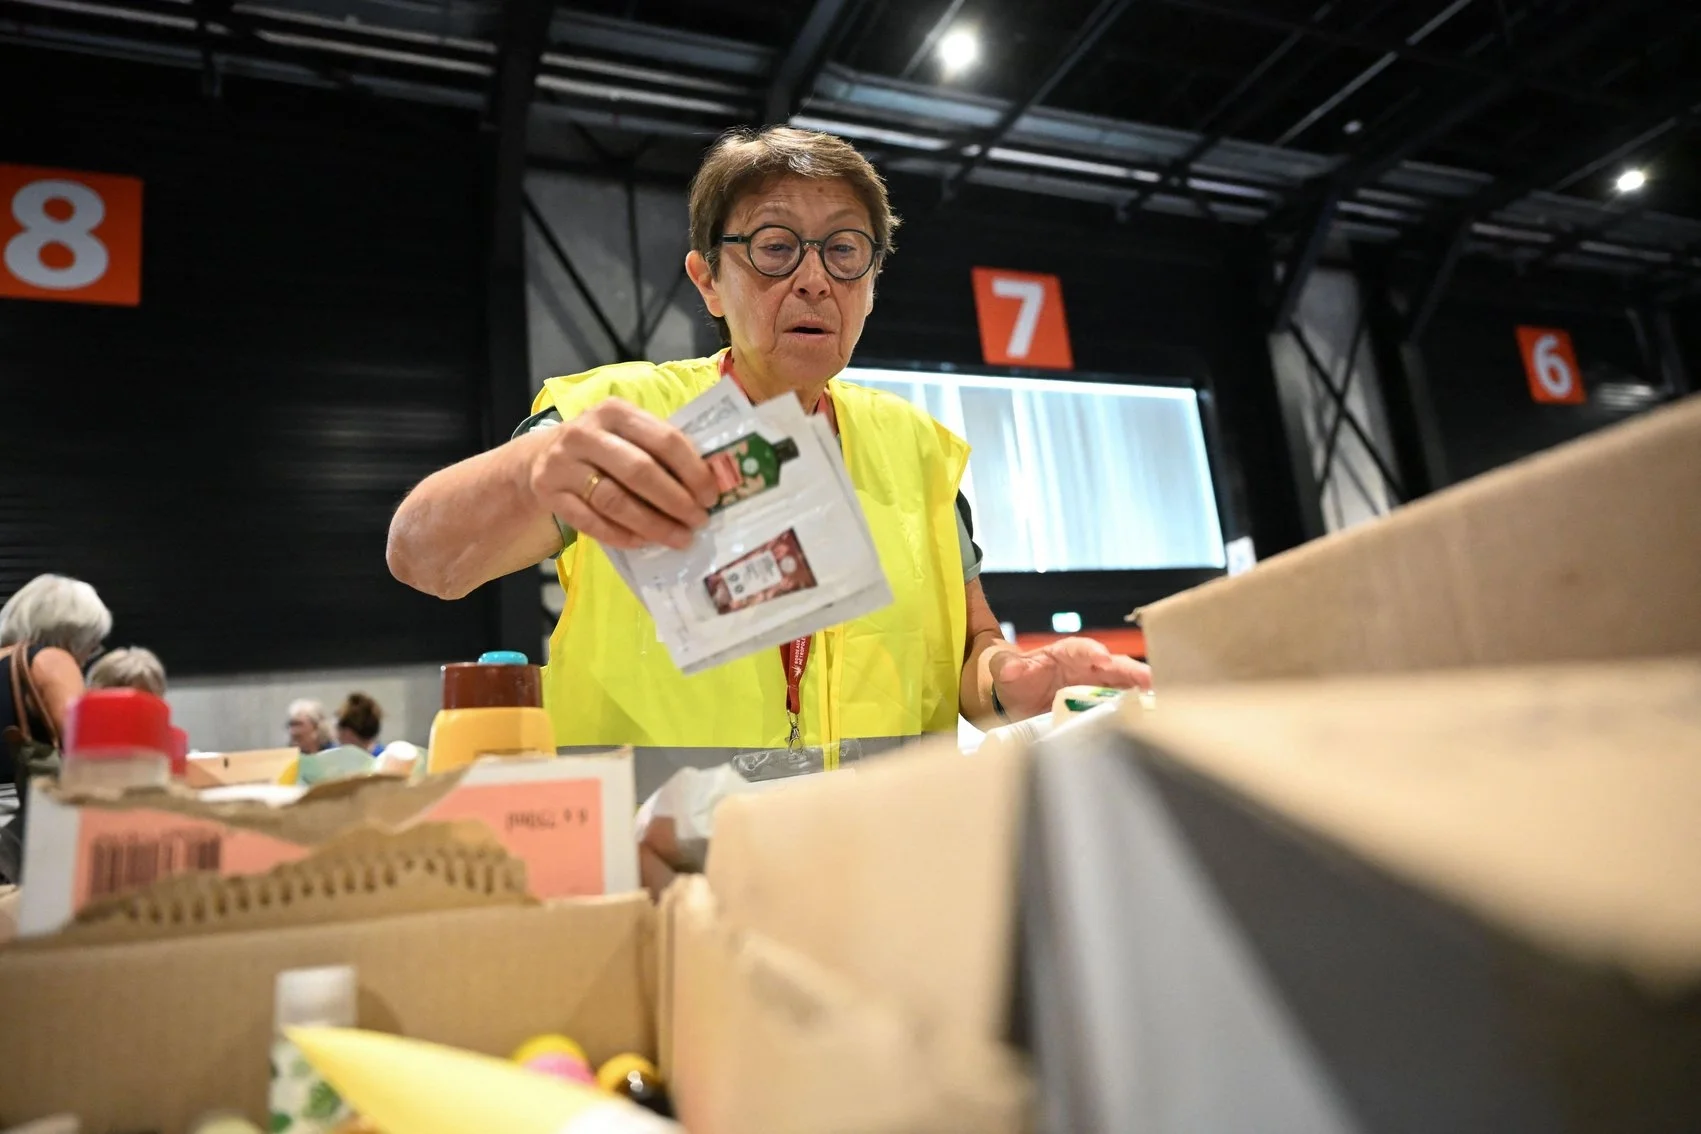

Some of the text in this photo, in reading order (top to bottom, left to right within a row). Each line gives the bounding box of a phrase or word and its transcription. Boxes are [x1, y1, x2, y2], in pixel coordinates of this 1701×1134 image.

[4, 180, 109, 290] 8
[991, 279, 1045, 358] 7
[1533, 335, 1571, 397] 6
